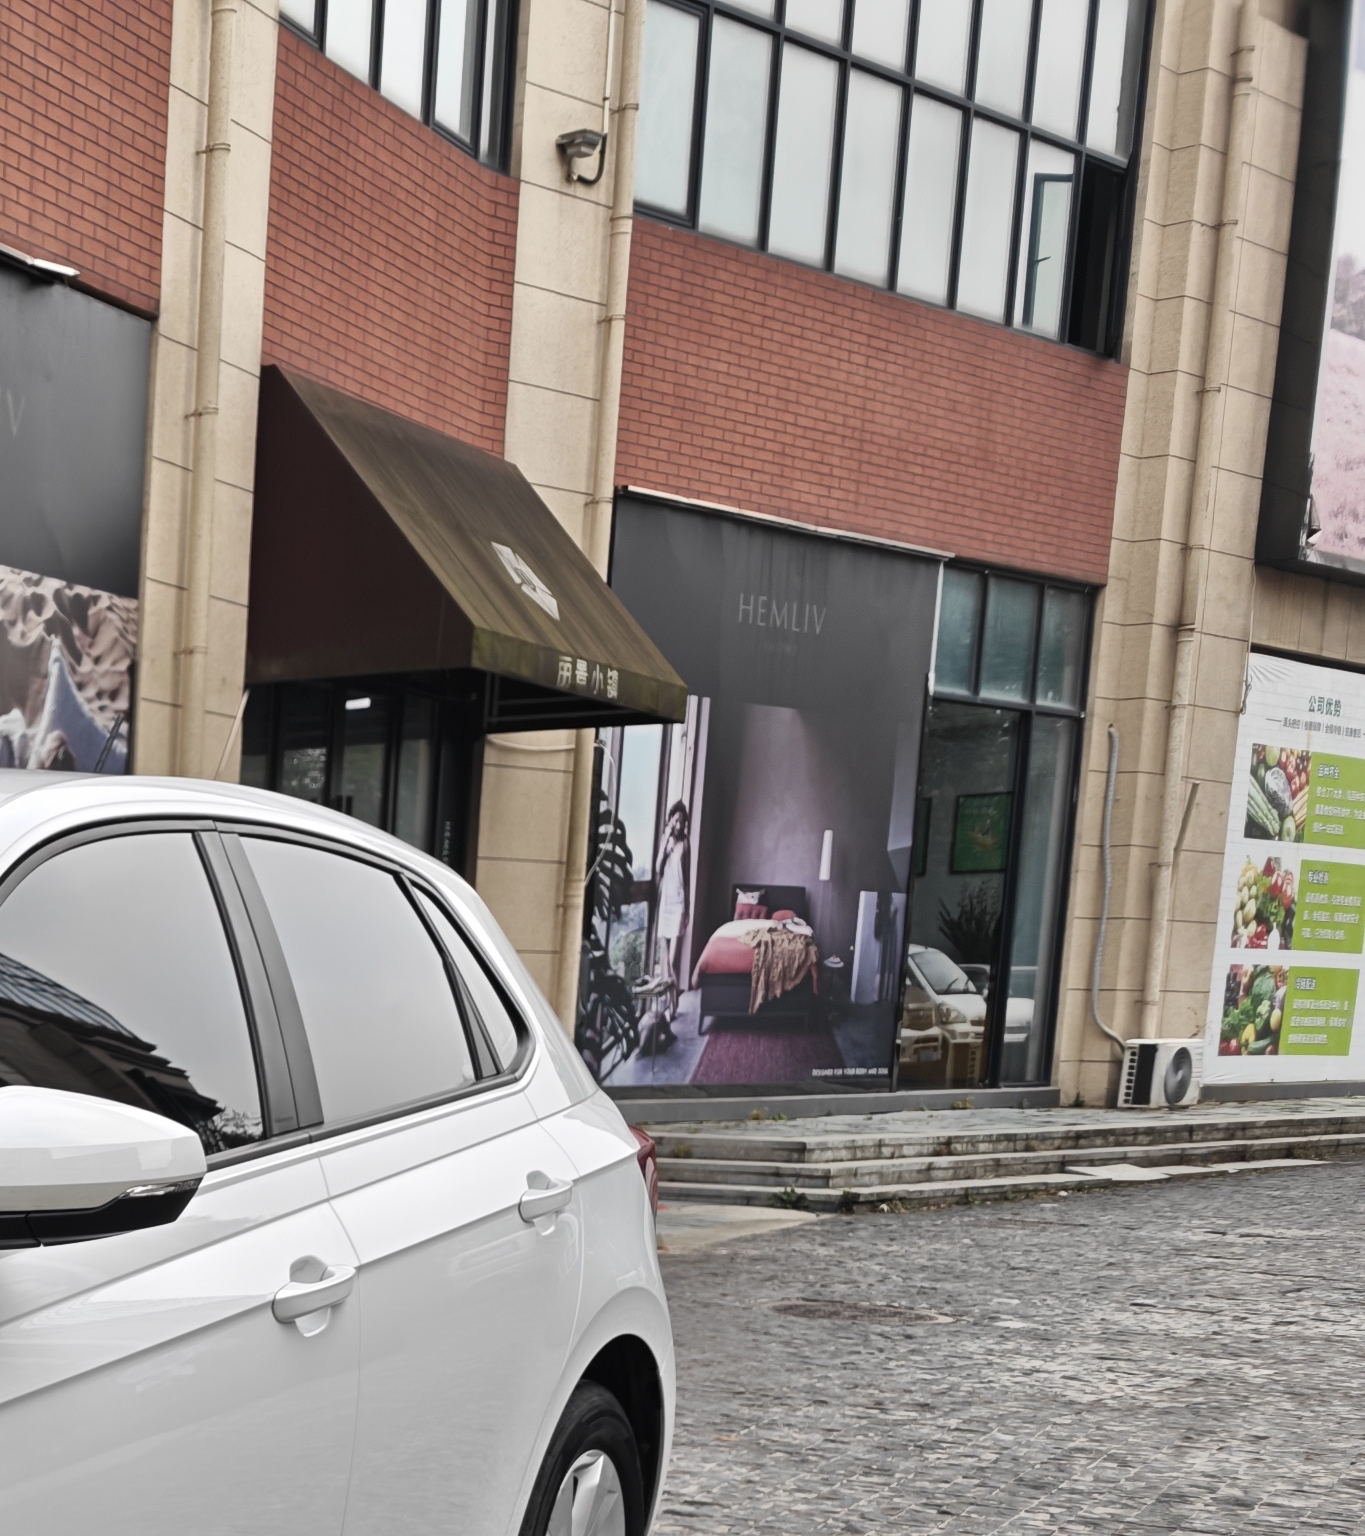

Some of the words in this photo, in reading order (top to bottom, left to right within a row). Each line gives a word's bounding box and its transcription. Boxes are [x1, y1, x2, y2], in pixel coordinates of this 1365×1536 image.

[738, 592, 827, 635] HEMLIV
[1308, 695, 1342, 718] 公司优势
